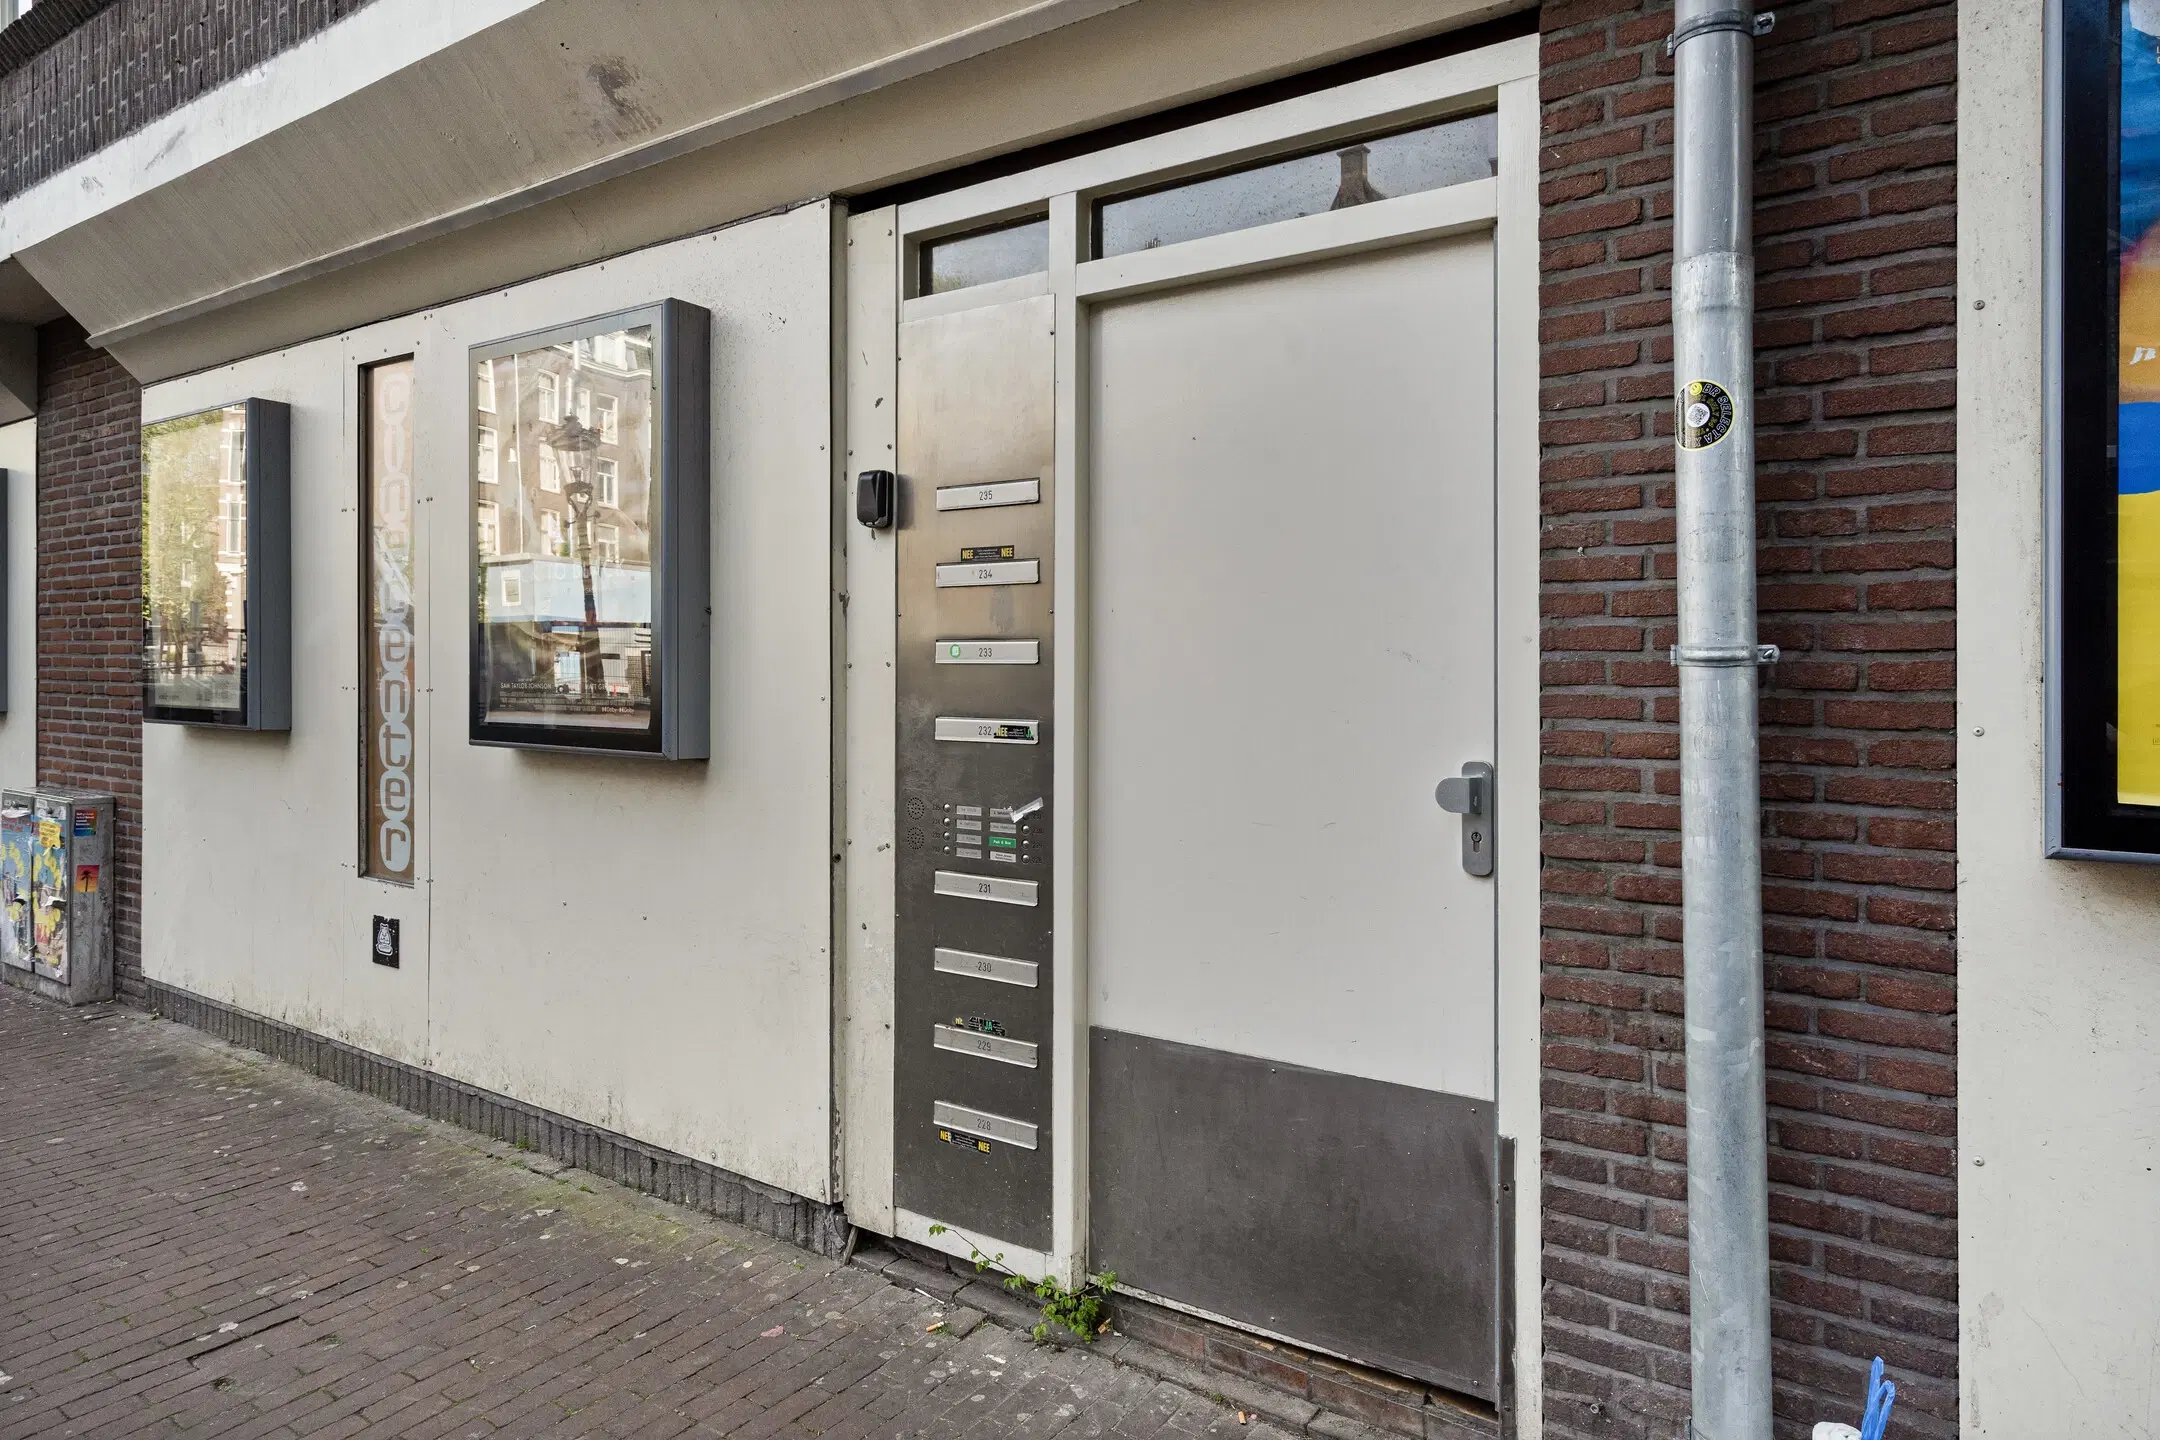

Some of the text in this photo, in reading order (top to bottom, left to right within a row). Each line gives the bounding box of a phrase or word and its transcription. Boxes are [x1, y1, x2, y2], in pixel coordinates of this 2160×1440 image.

[978, 490, 993, 501] 235
[962, 549, 974, 560] NEE
[1001, 547, 1013, 557] NEE
[978, 569, 993, 579] 234
[978, 647, 993, 658] 233
[978, 725, 992, 736] 232
[996, 727, 1008, 737] NEE
[978, 882, 992, 894] 231
[977, 961, 992, 973] 230
[985, 1020, 993, 1031] JA
[977, 1040, 992, 1051] 229
[977, 1118, 991, 1131] 228
[940, 1130, 952, 1142] NEE
[978, 1140, 991, 1153] NEE
